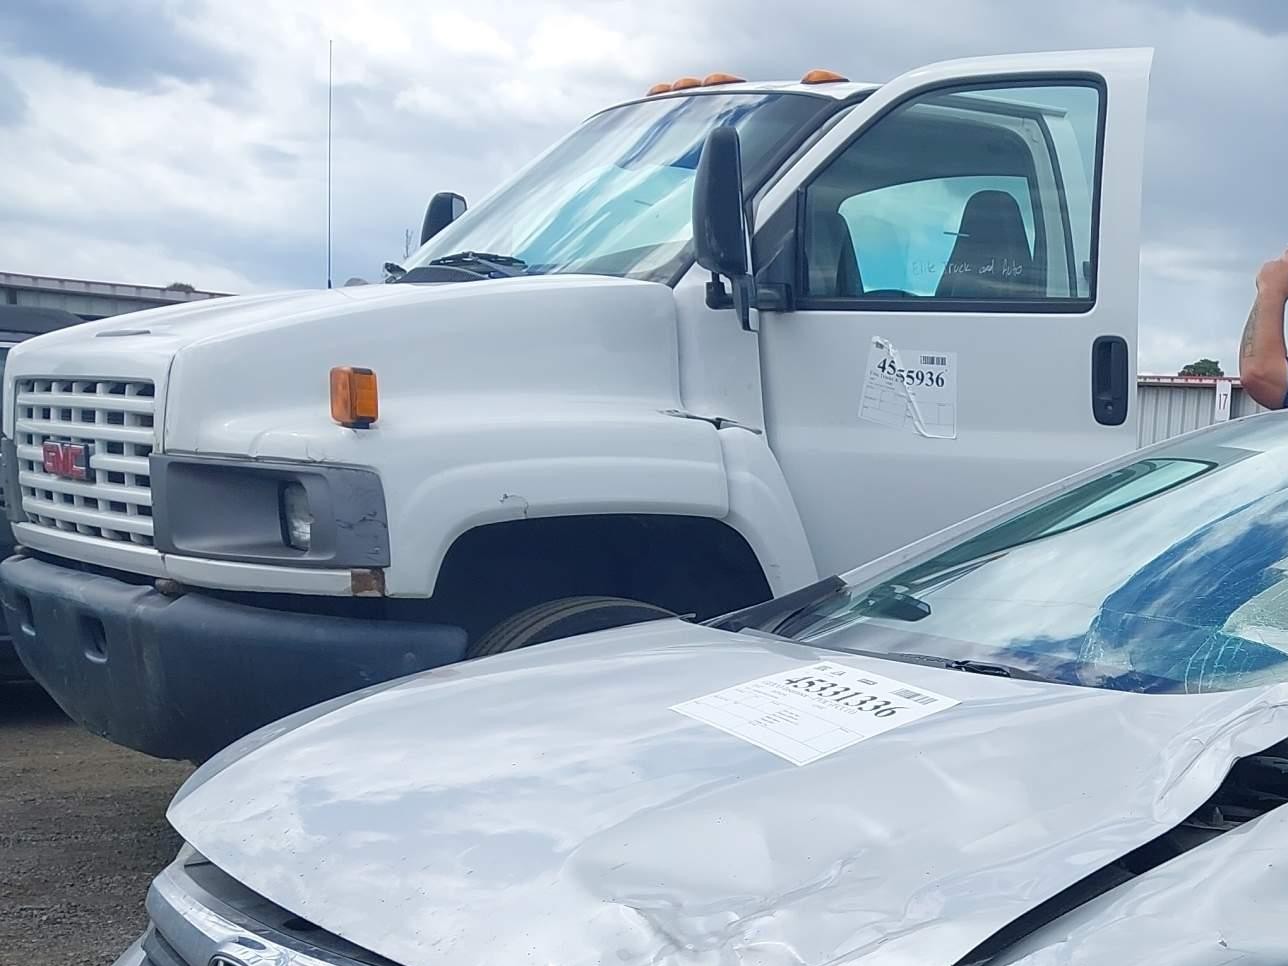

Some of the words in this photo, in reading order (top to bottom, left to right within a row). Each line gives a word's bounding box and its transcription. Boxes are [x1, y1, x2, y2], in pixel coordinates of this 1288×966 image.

[1218, 393, 1229, 410] 17
[43, 441, 86, 479] GMC
[785, 676, 909, 718] 45331336
